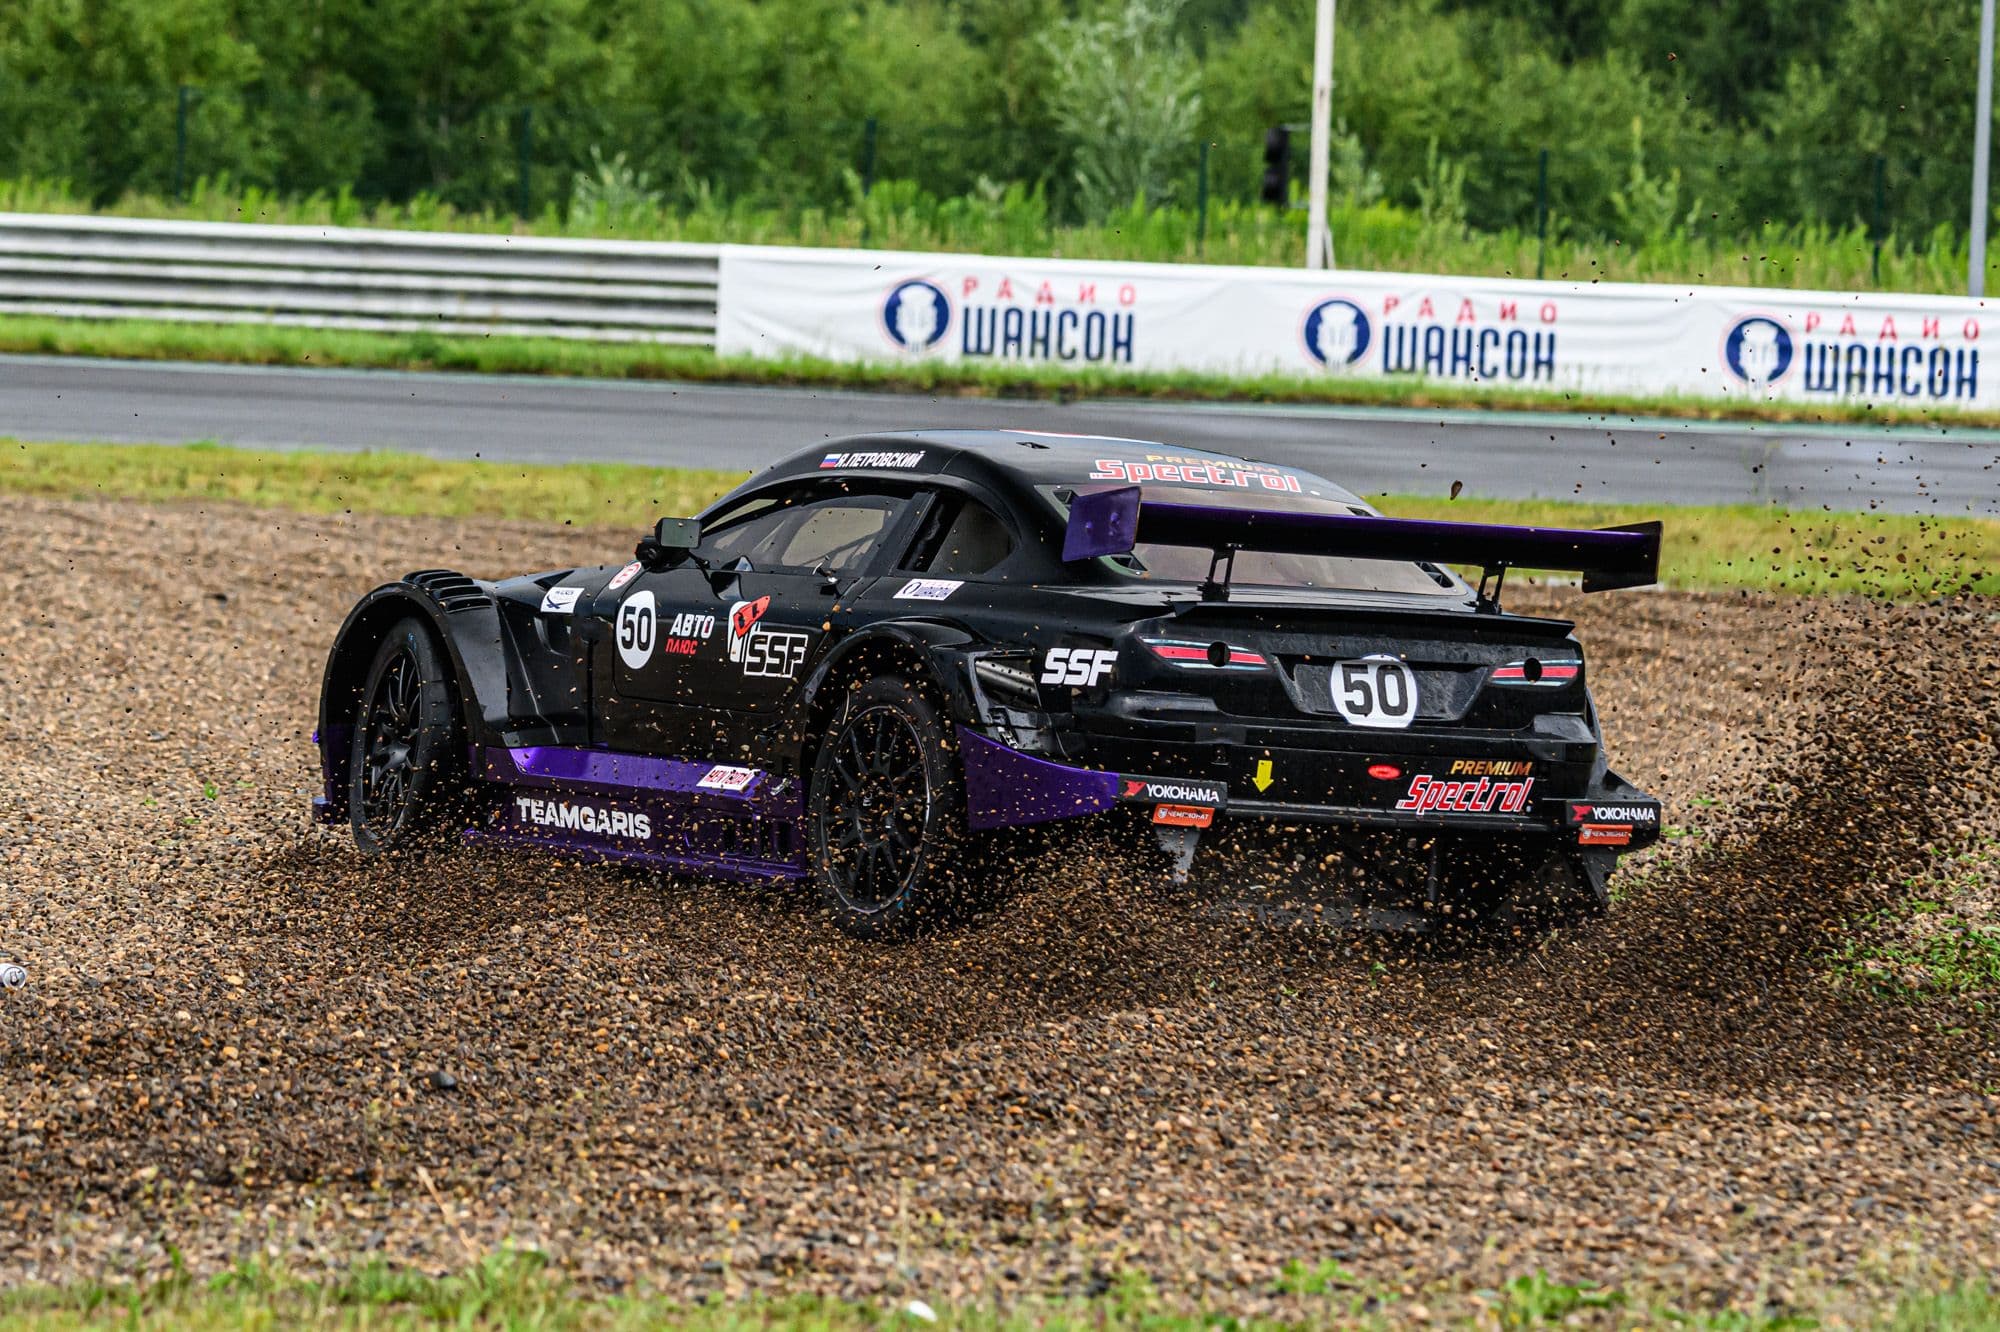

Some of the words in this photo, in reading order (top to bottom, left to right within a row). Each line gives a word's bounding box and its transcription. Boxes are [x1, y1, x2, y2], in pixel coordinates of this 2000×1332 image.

[963, 276, 1136, 306] РАДИО
[1383, 297, 1557, 324] РАДИО
[1805, 311, 1981, 340] РАДИО
[962, 306, 1135, 362] ШАНСОН
[1383, 325, 1556, 380] ШАНСОН
[1804, 342, 1979, 398] ШАНСОН
[1089, 459, 1302, 493] Spectrol
[1145, 454, 1281, 475] PREMIUM
[621, 605, 651, 651] 50
[669, 612, 715, 639] АВТО
[665, 638, 698, 655] ПЛЮС
[743, 630, 808, 679] SSF
[1040, 648, 1119, 687] SSF
[1341, 663, 1408, 717] 50
[1450, 760, 1533, 776] PREMIUM
[1146, 783, 1220, 803] YOKOHAMA
[1396, 765, 1535, 815] Spectrol
[516, 796, 651, 839] TEAMGARIS
[1592, 806, 1656, 821] YOKOHAMA
